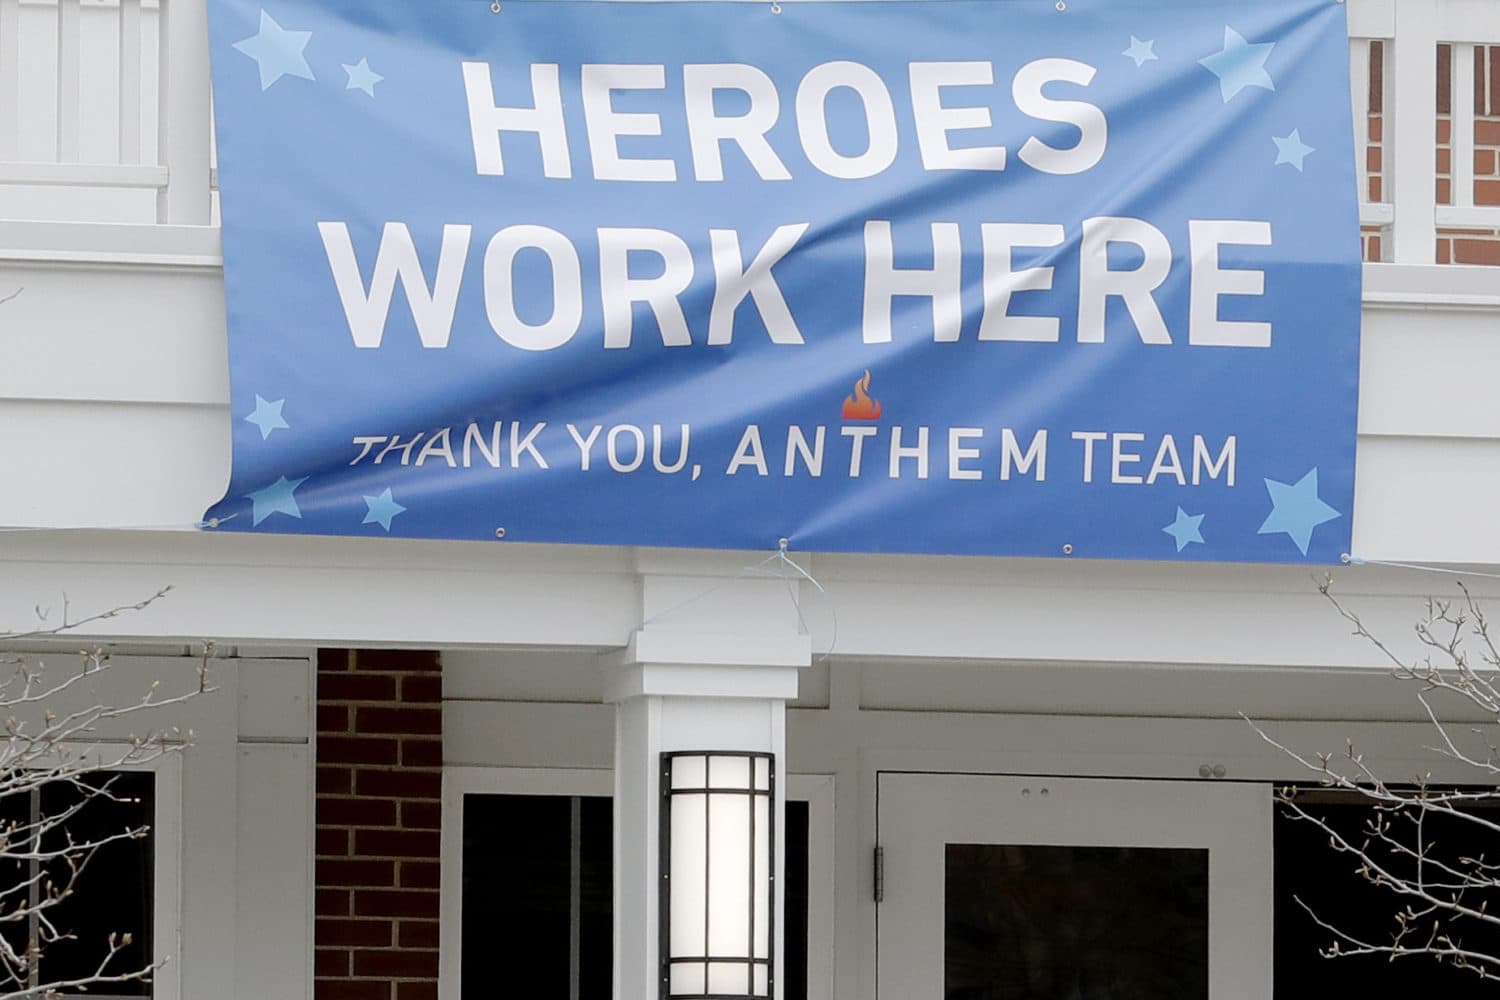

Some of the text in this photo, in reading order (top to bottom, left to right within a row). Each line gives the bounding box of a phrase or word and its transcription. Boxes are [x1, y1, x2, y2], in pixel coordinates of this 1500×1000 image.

[460, 57, 1108, 183] HEROES
[316, 216, 1273, 352] WORK HERE
[352, 421, 1236, 486] THANK YOU, ANTHEM TEAM
